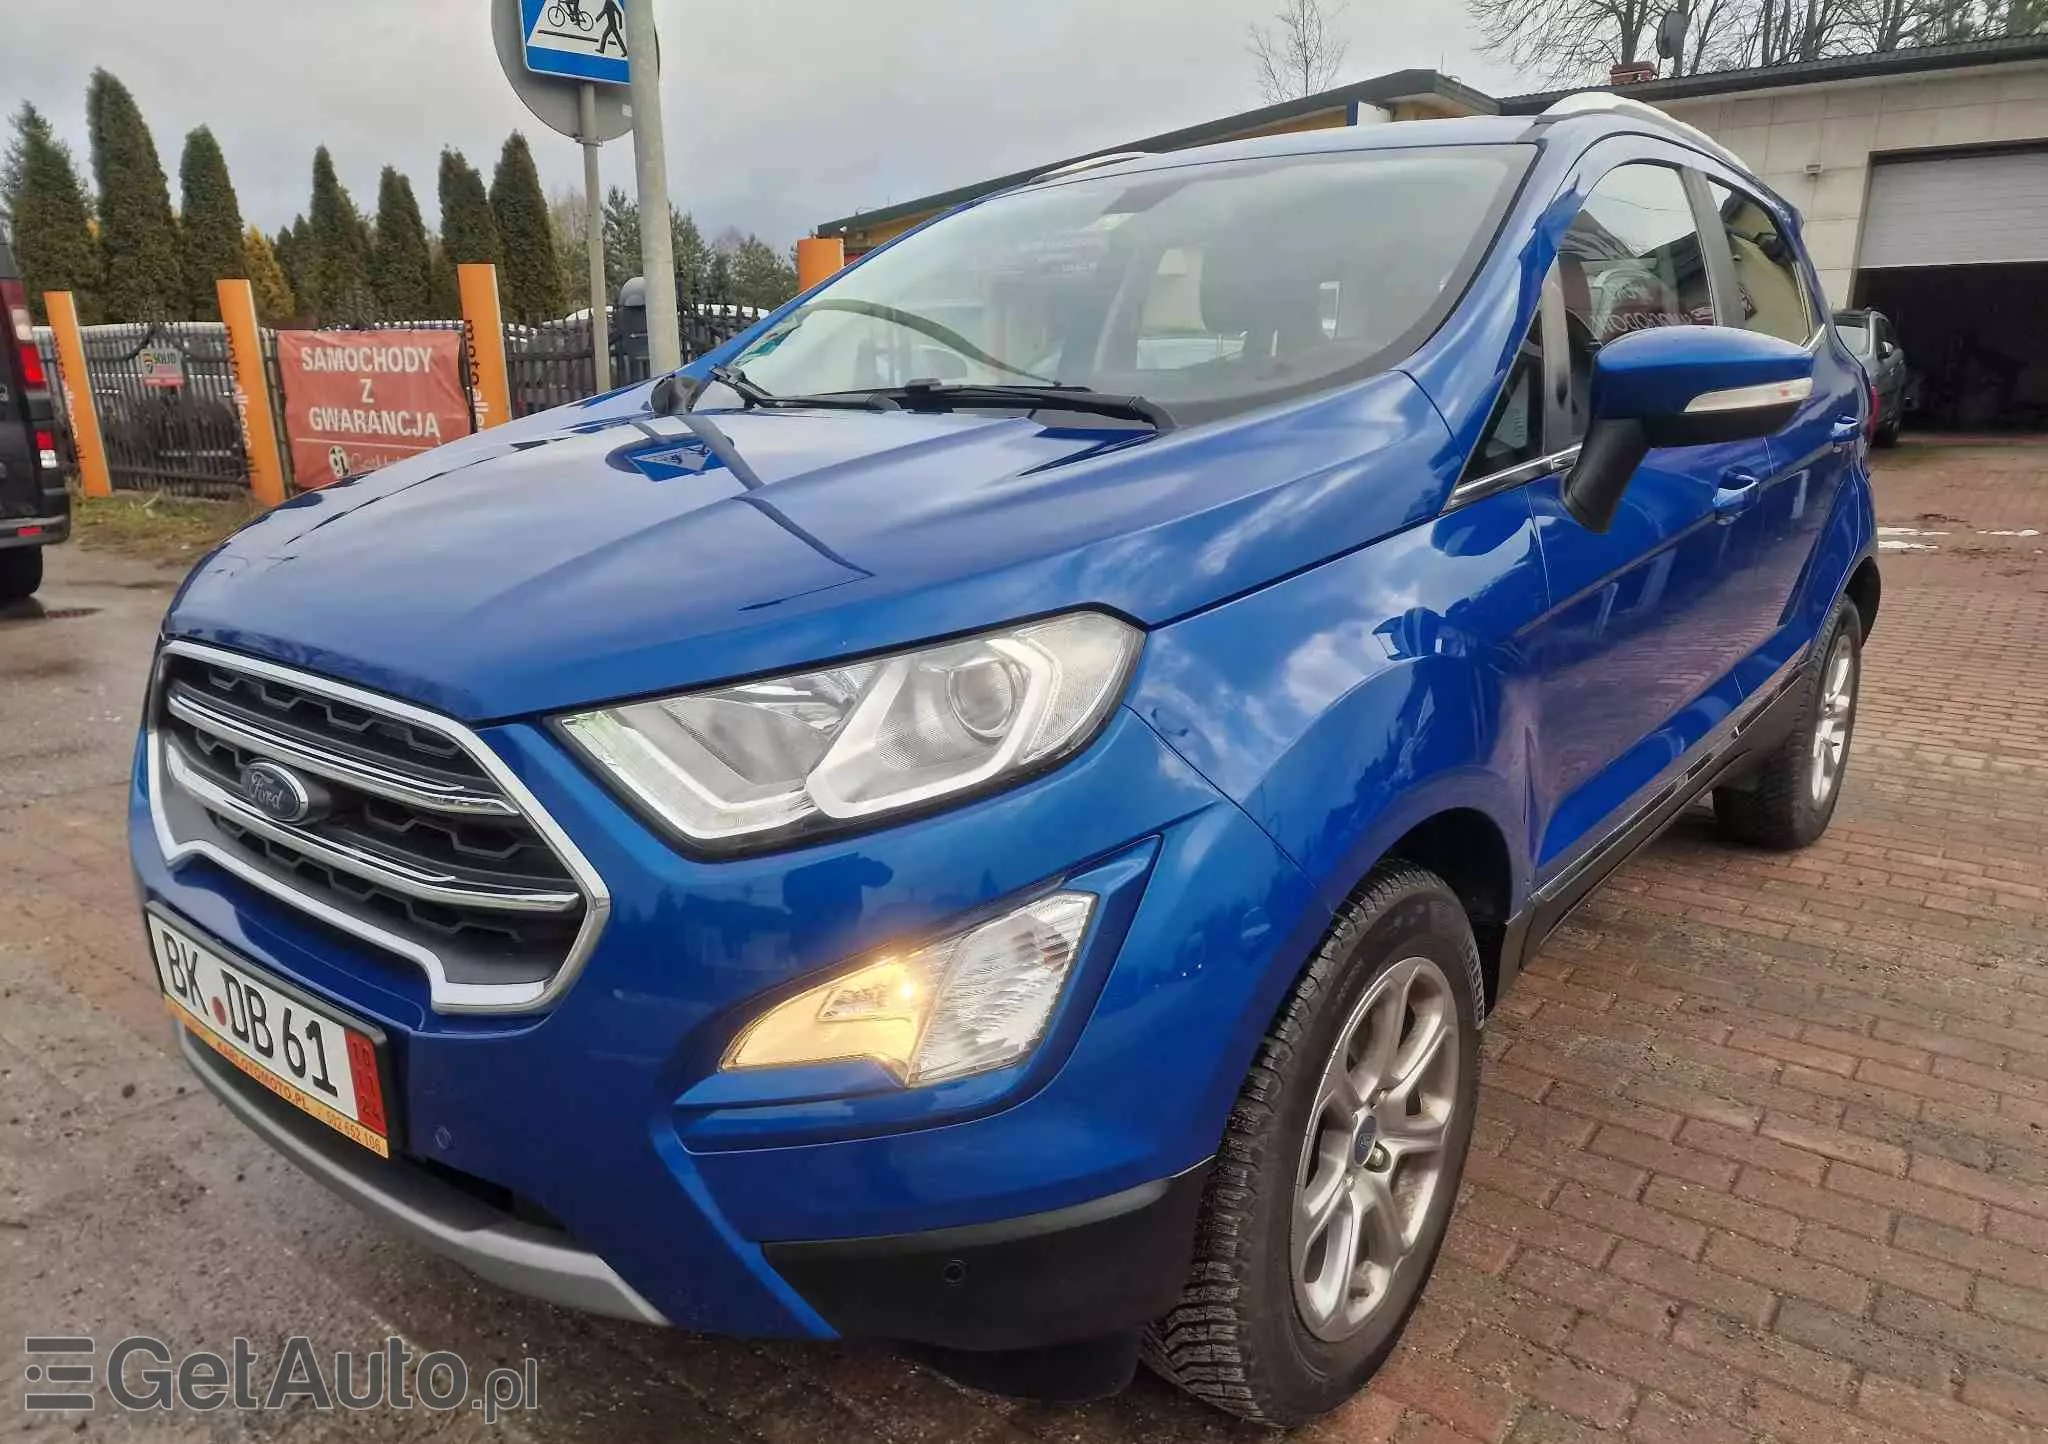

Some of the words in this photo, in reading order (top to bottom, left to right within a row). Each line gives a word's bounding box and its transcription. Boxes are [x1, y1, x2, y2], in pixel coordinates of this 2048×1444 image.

[301, 346, 433, 374] SAMOCHODY
[359, 378, 375, 404] Z
[308, 406, 442, 446] GWARANCJĄ
[248, 771, 284, 810] Ford
[162, 929, 209, 1017] BK
[220, 968, 274, 1059] DB
[282, 1007, 338, 1098] 61
